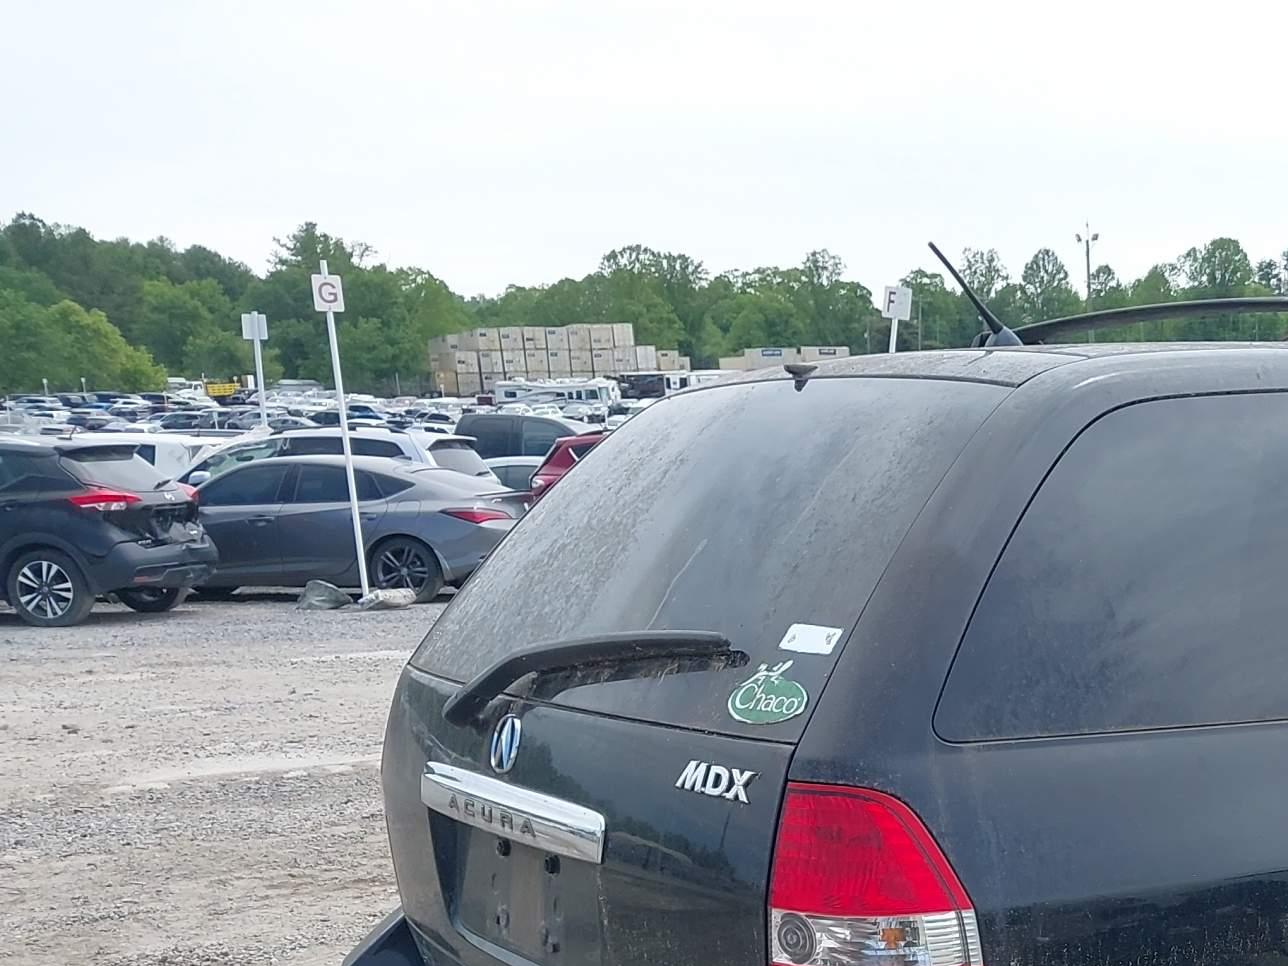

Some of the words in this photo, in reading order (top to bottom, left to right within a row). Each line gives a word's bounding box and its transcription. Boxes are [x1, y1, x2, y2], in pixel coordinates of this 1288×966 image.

[318, 282, 338, 304] G
[887, 291, 897, 312] F
[735, 683, 799, 714] Chaco
[675, 759, 757, 804] MDX
[448, 793, 537, 838] ACURA
